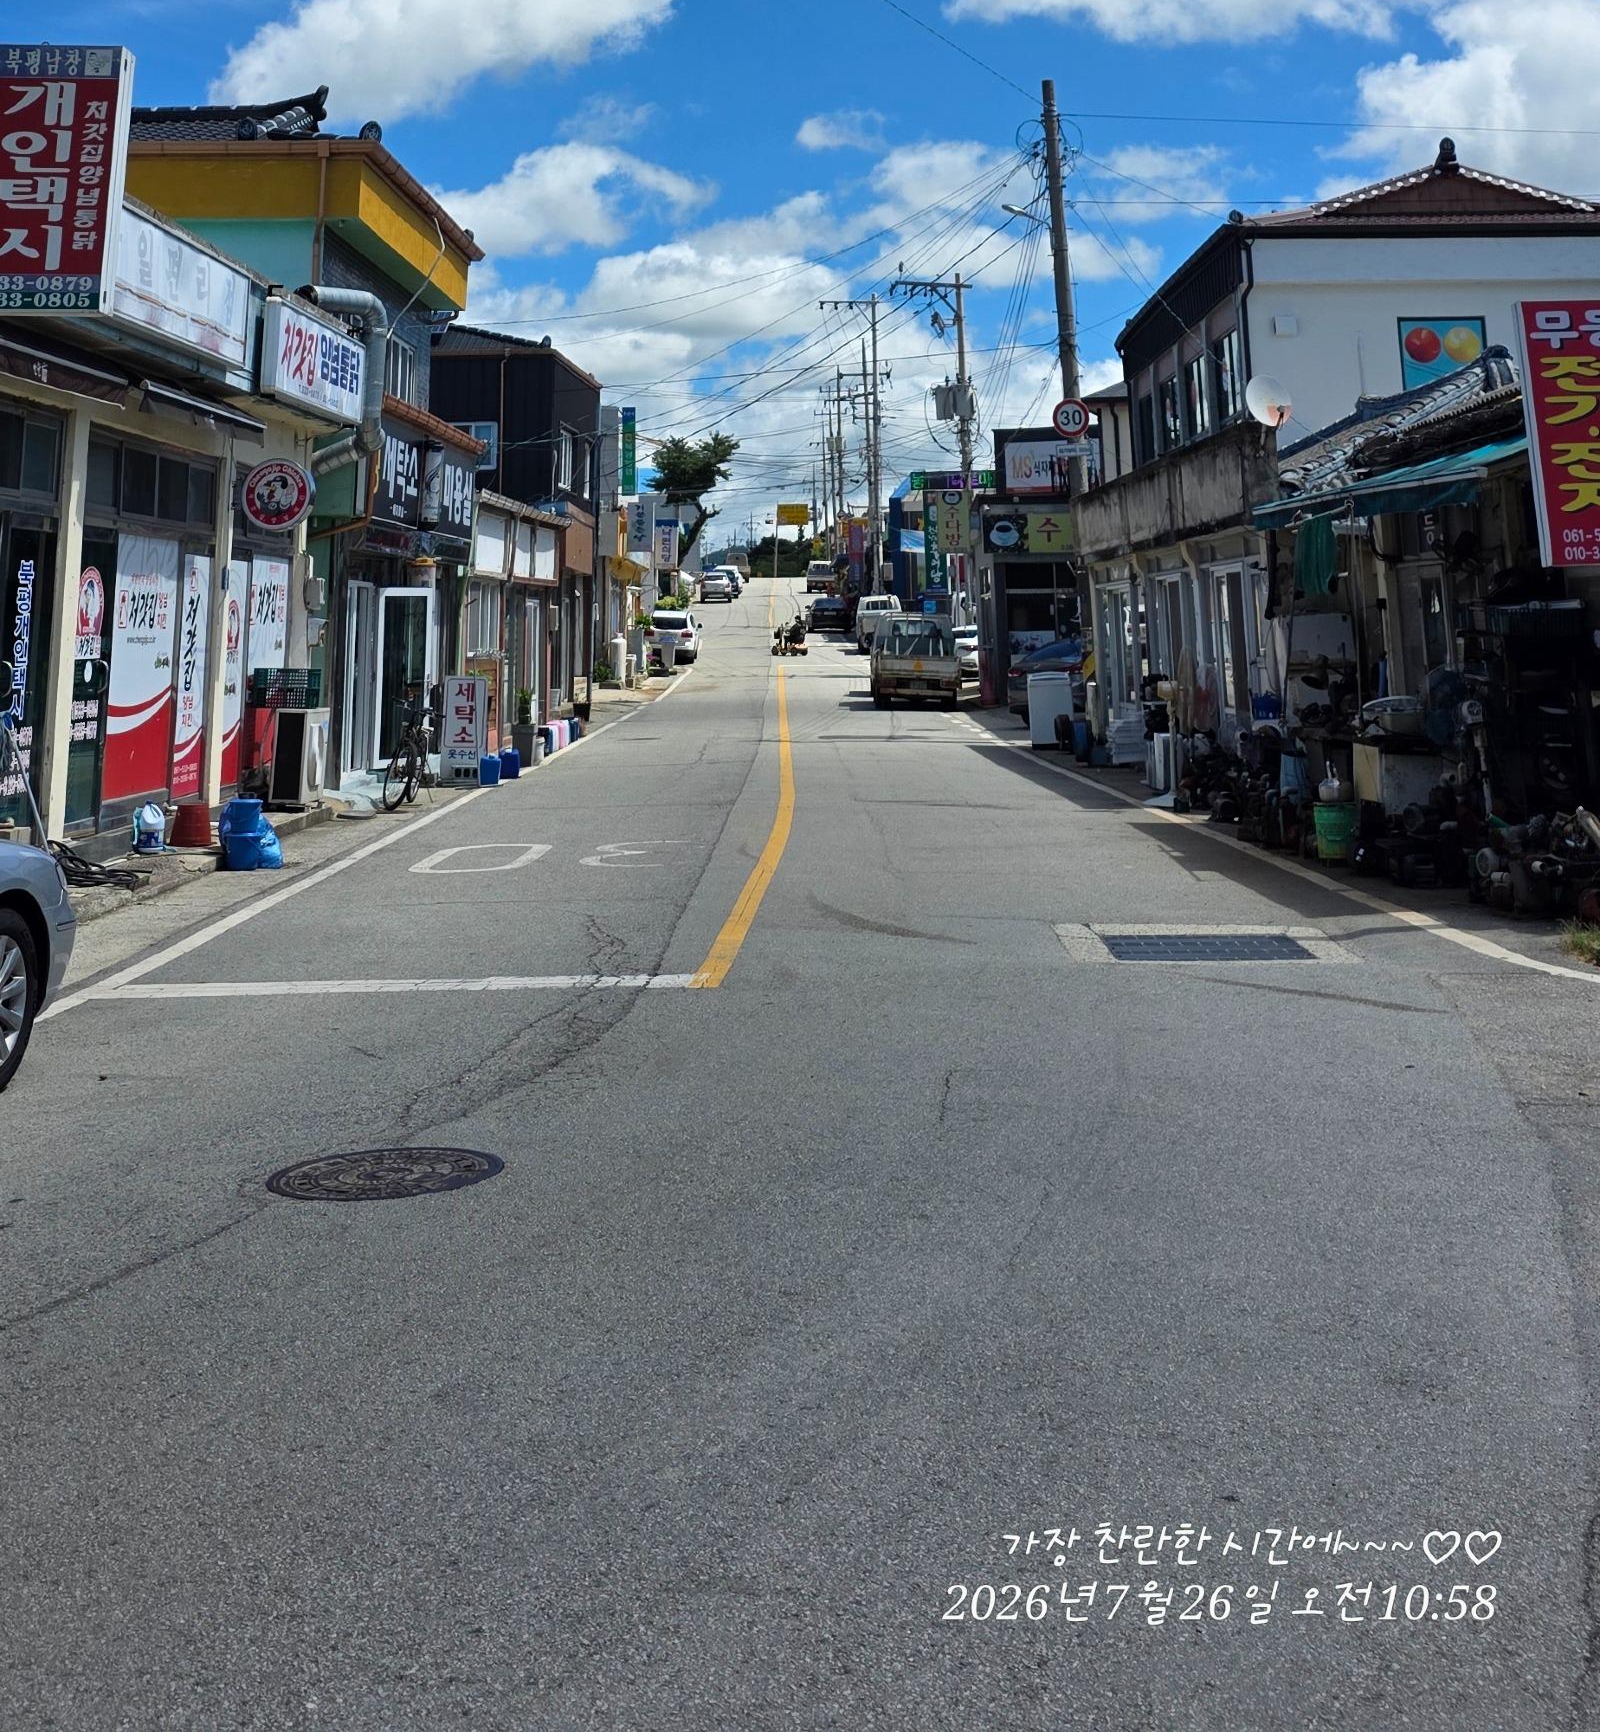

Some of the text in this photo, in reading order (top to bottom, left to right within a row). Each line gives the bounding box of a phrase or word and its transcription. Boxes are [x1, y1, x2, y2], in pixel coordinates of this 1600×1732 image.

[0, 81, 77, 271] 개인택시
[71, 100, 109, 251] 처갓집양념통닭
[281, 318, 319, 387] 처갓집
[1060, 410, 1082, 426] 30
[382, 436, 418, 502] 세탁소
[443, 464, 473, 526] 미용실
[9, 560, 34, 721] 북평개인택시
[129, 591, 158, 629] 처갓집
[184, 594, 200, 692] 처갓집
[452, 683, 475, 743] 세탁소
